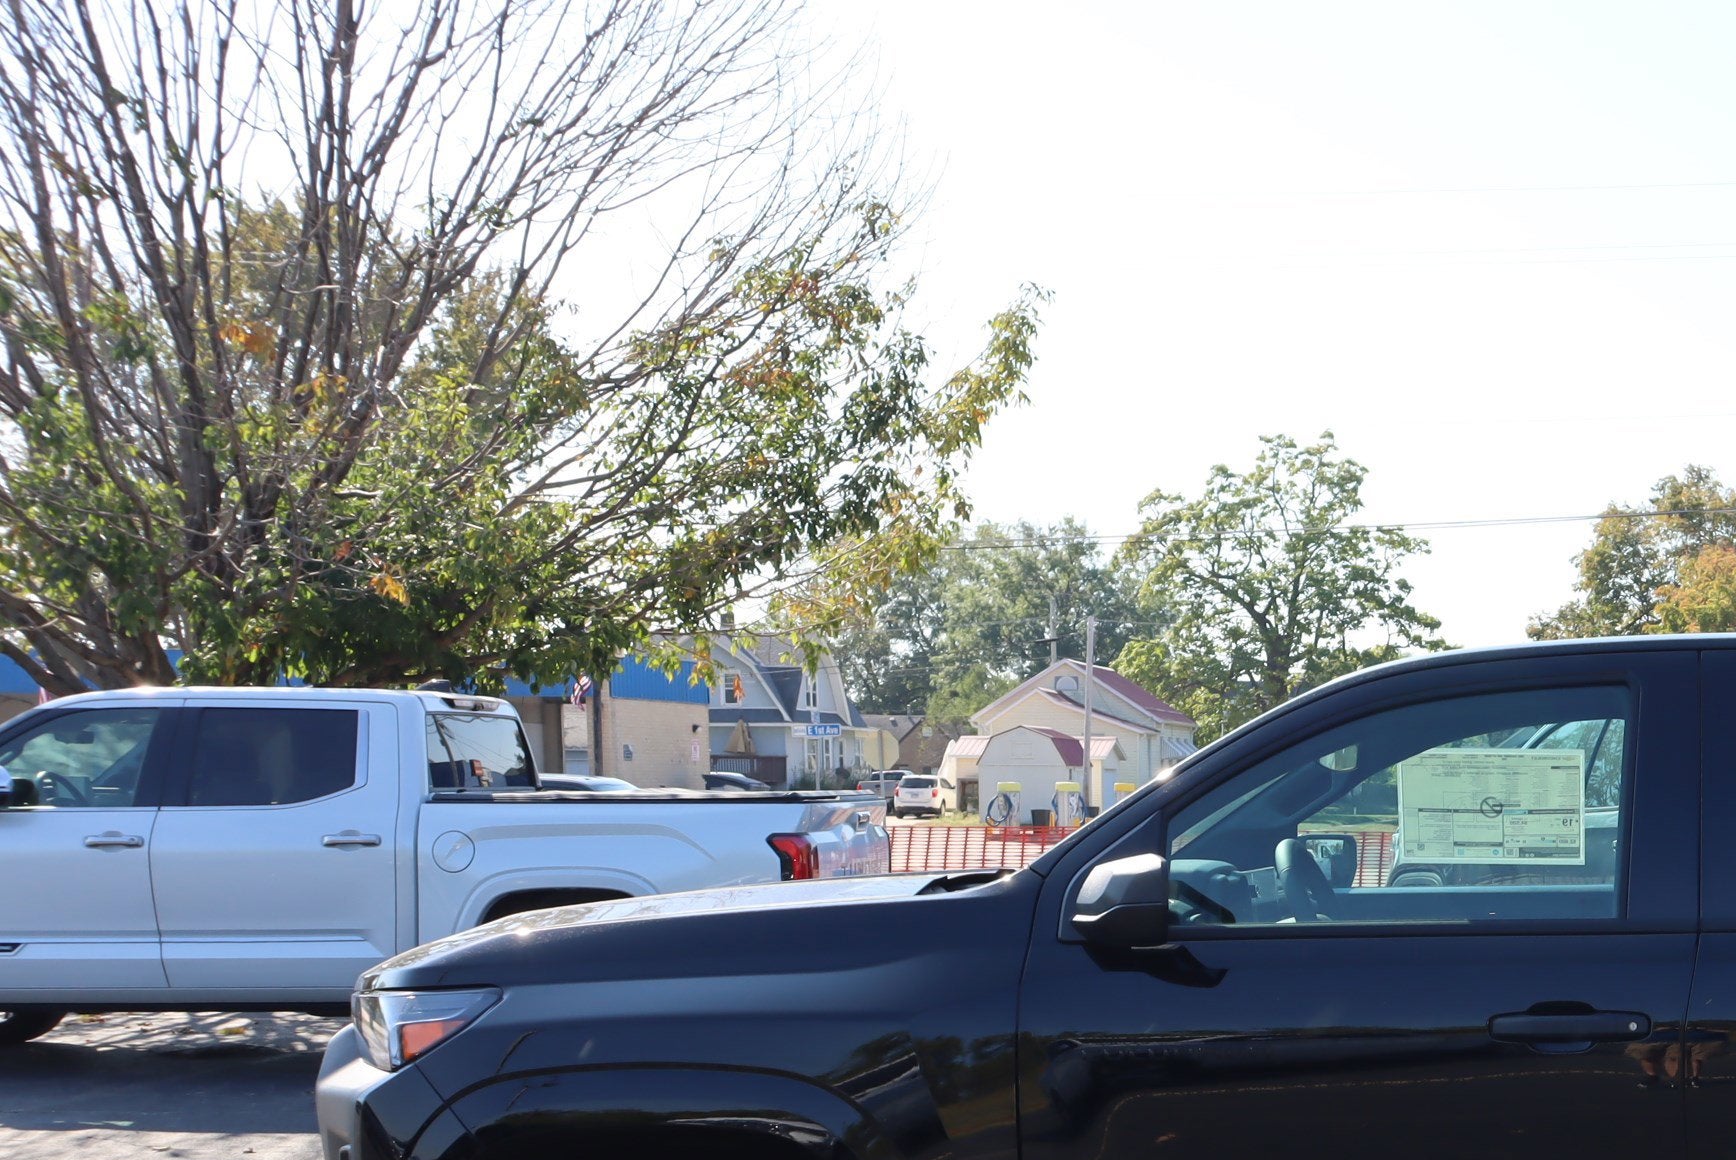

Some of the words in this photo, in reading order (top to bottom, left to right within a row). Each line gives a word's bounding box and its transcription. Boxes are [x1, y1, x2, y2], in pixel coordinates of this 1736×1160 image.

[808, 726, 813, 735] E
[815, 726, 825, 735] 1st
[826, 726, 839, 735] Ave
